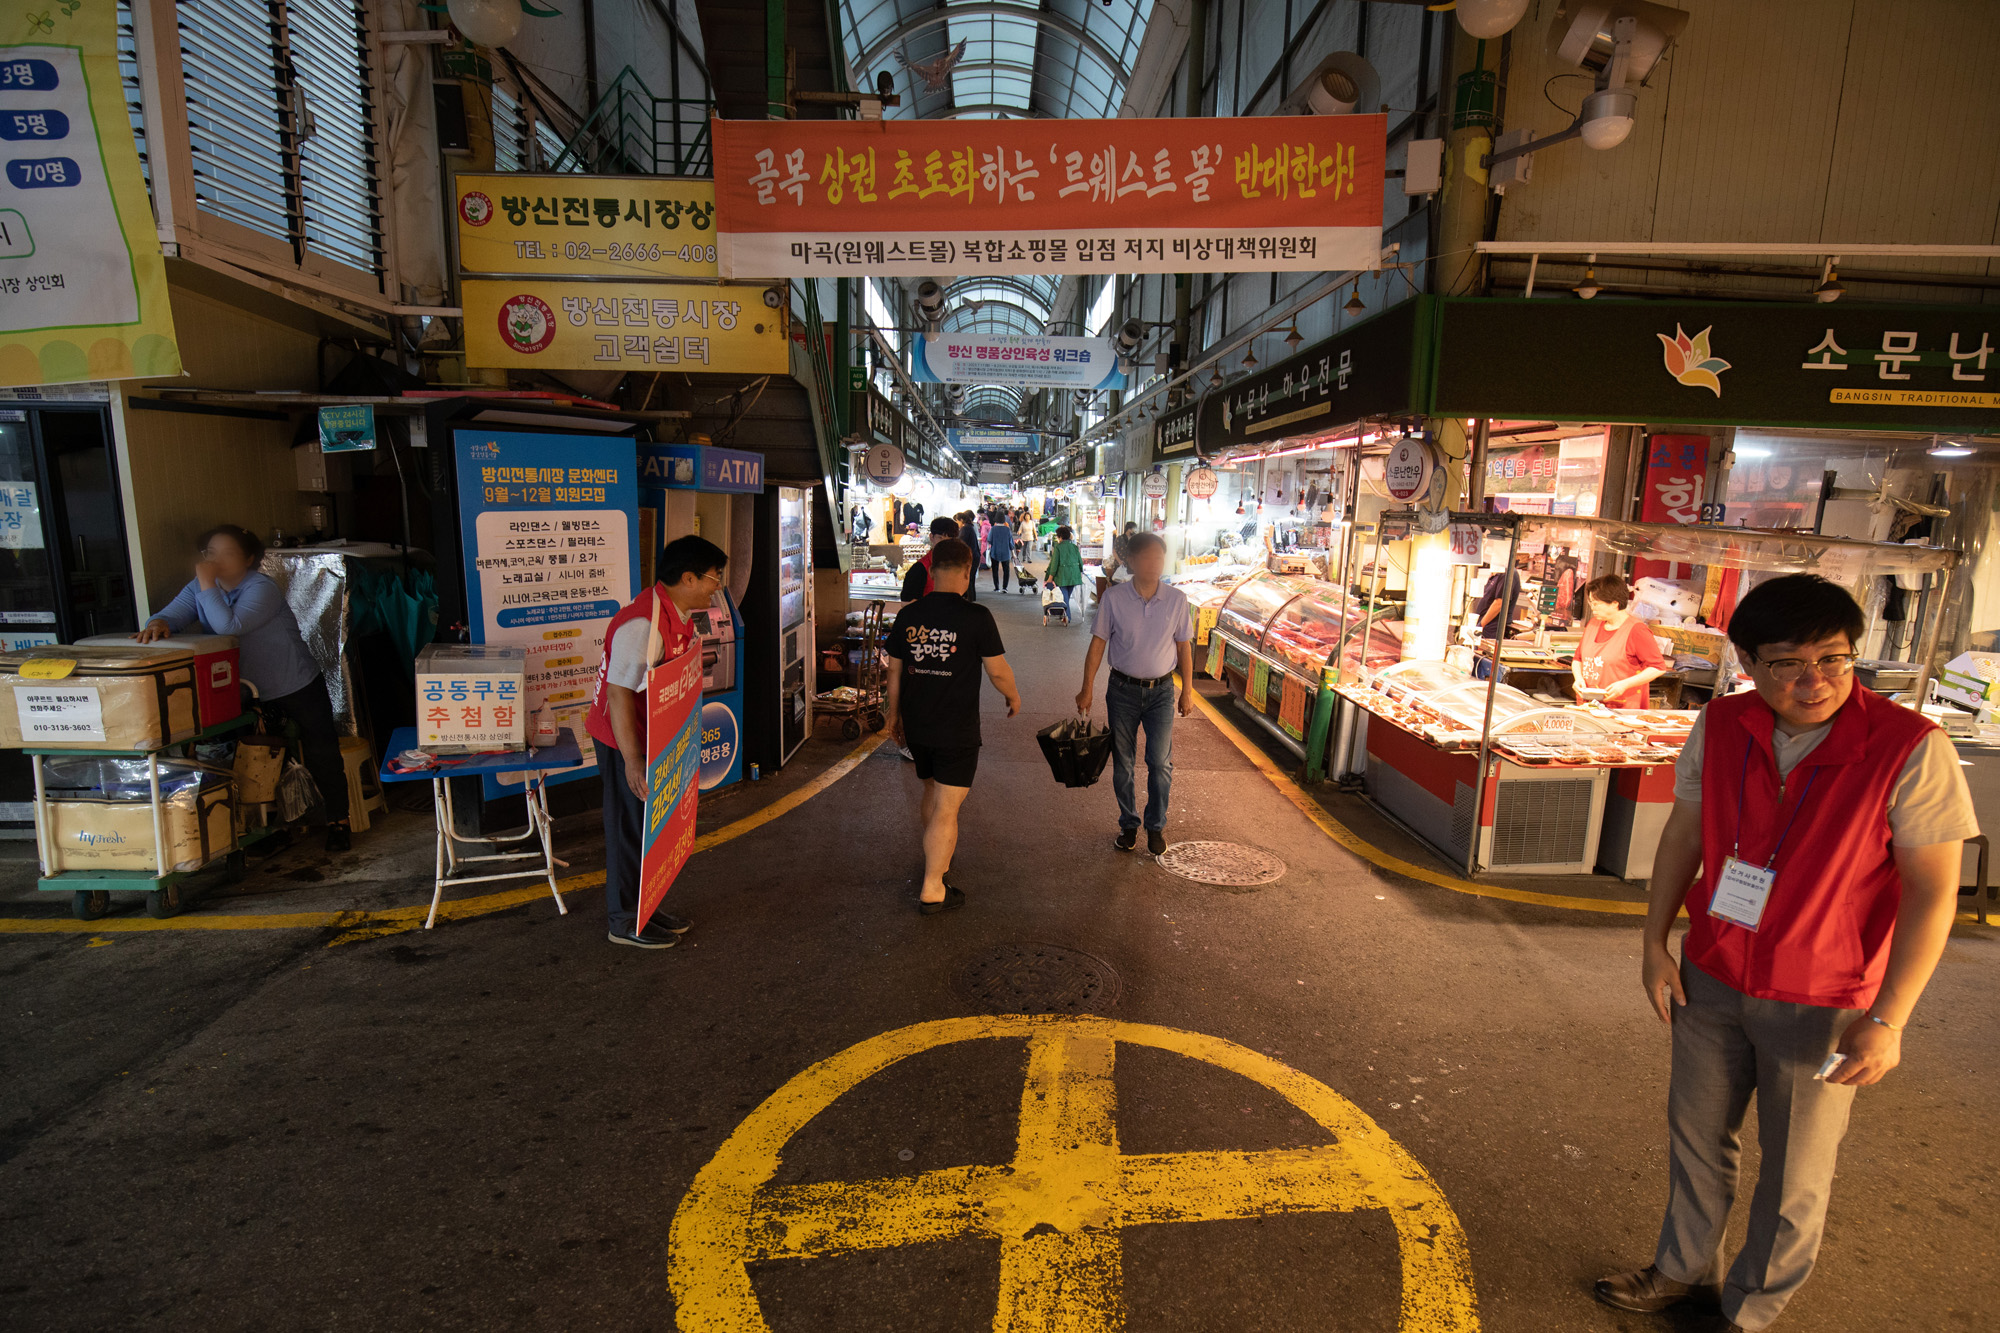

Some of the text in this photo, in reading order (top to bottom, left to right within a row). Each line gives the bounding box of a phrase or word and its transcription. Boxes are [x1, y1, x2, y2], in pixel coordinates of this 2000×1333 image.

[2, 62, 34, 86] 3명
[13, 113, 49, 136] 5명
[19, 161, 67, 184] 70명
[748, 147, 811, 207] 골목
[819, 145, 879, 205] 상권
[887, 145, 1041, 205] 초토화하는
[1234, 141, 1356, 202] 반대한다!
[514, 240, 546, 259] TEL
[790, 236, 1318, 266] 마곡(원웨스트몰) 복합쇼핑몰 입점 저지 비상대책위원회
[25, 273, 66, 292] 상인회
[561, 296, 742, 331] 방신전통시장
[593, 334, 710, 365] 고객쉼터
[948, 345, 1092, 363] 방신 명품상인육성 워크숍
[1801, 328, 1995, 382] 소문난
[1835, 391, 1892, 402] BANGSIN
[1900, 393, 1985, 405] TRADITIONAL
[343, 409, 366, 419] 24시간
[481, 466, 618, 484] 방신전통시장 문화센터
[718, 458, 760, 485] ATM
[880, 460, 892, 475] 닭
[1387, 465, 1421, 479] 소문난한우
[555, 486, 606, 503] 회원모집
[509, 521, 551, 533] 라인댄스
[561, 520, 601, 531] 웰빙댄스
[505, 538, 557, 550] 스포츠댄스
[567, 536, 606, 548] 필라테스
[578, 552, 598, 564] 요가
[502, 571, 544, 584] 노래교실
[558, 569, 585, 580] 시니어
[588, 568, 606, 579] 줌바
[540, 672, 552, 681] 3층
[422, 680, 518, 702] 공동쿠폰
[440, 732, 512, 742] 방신전통시장 상인회
[701, 727, 721, 745] 365
